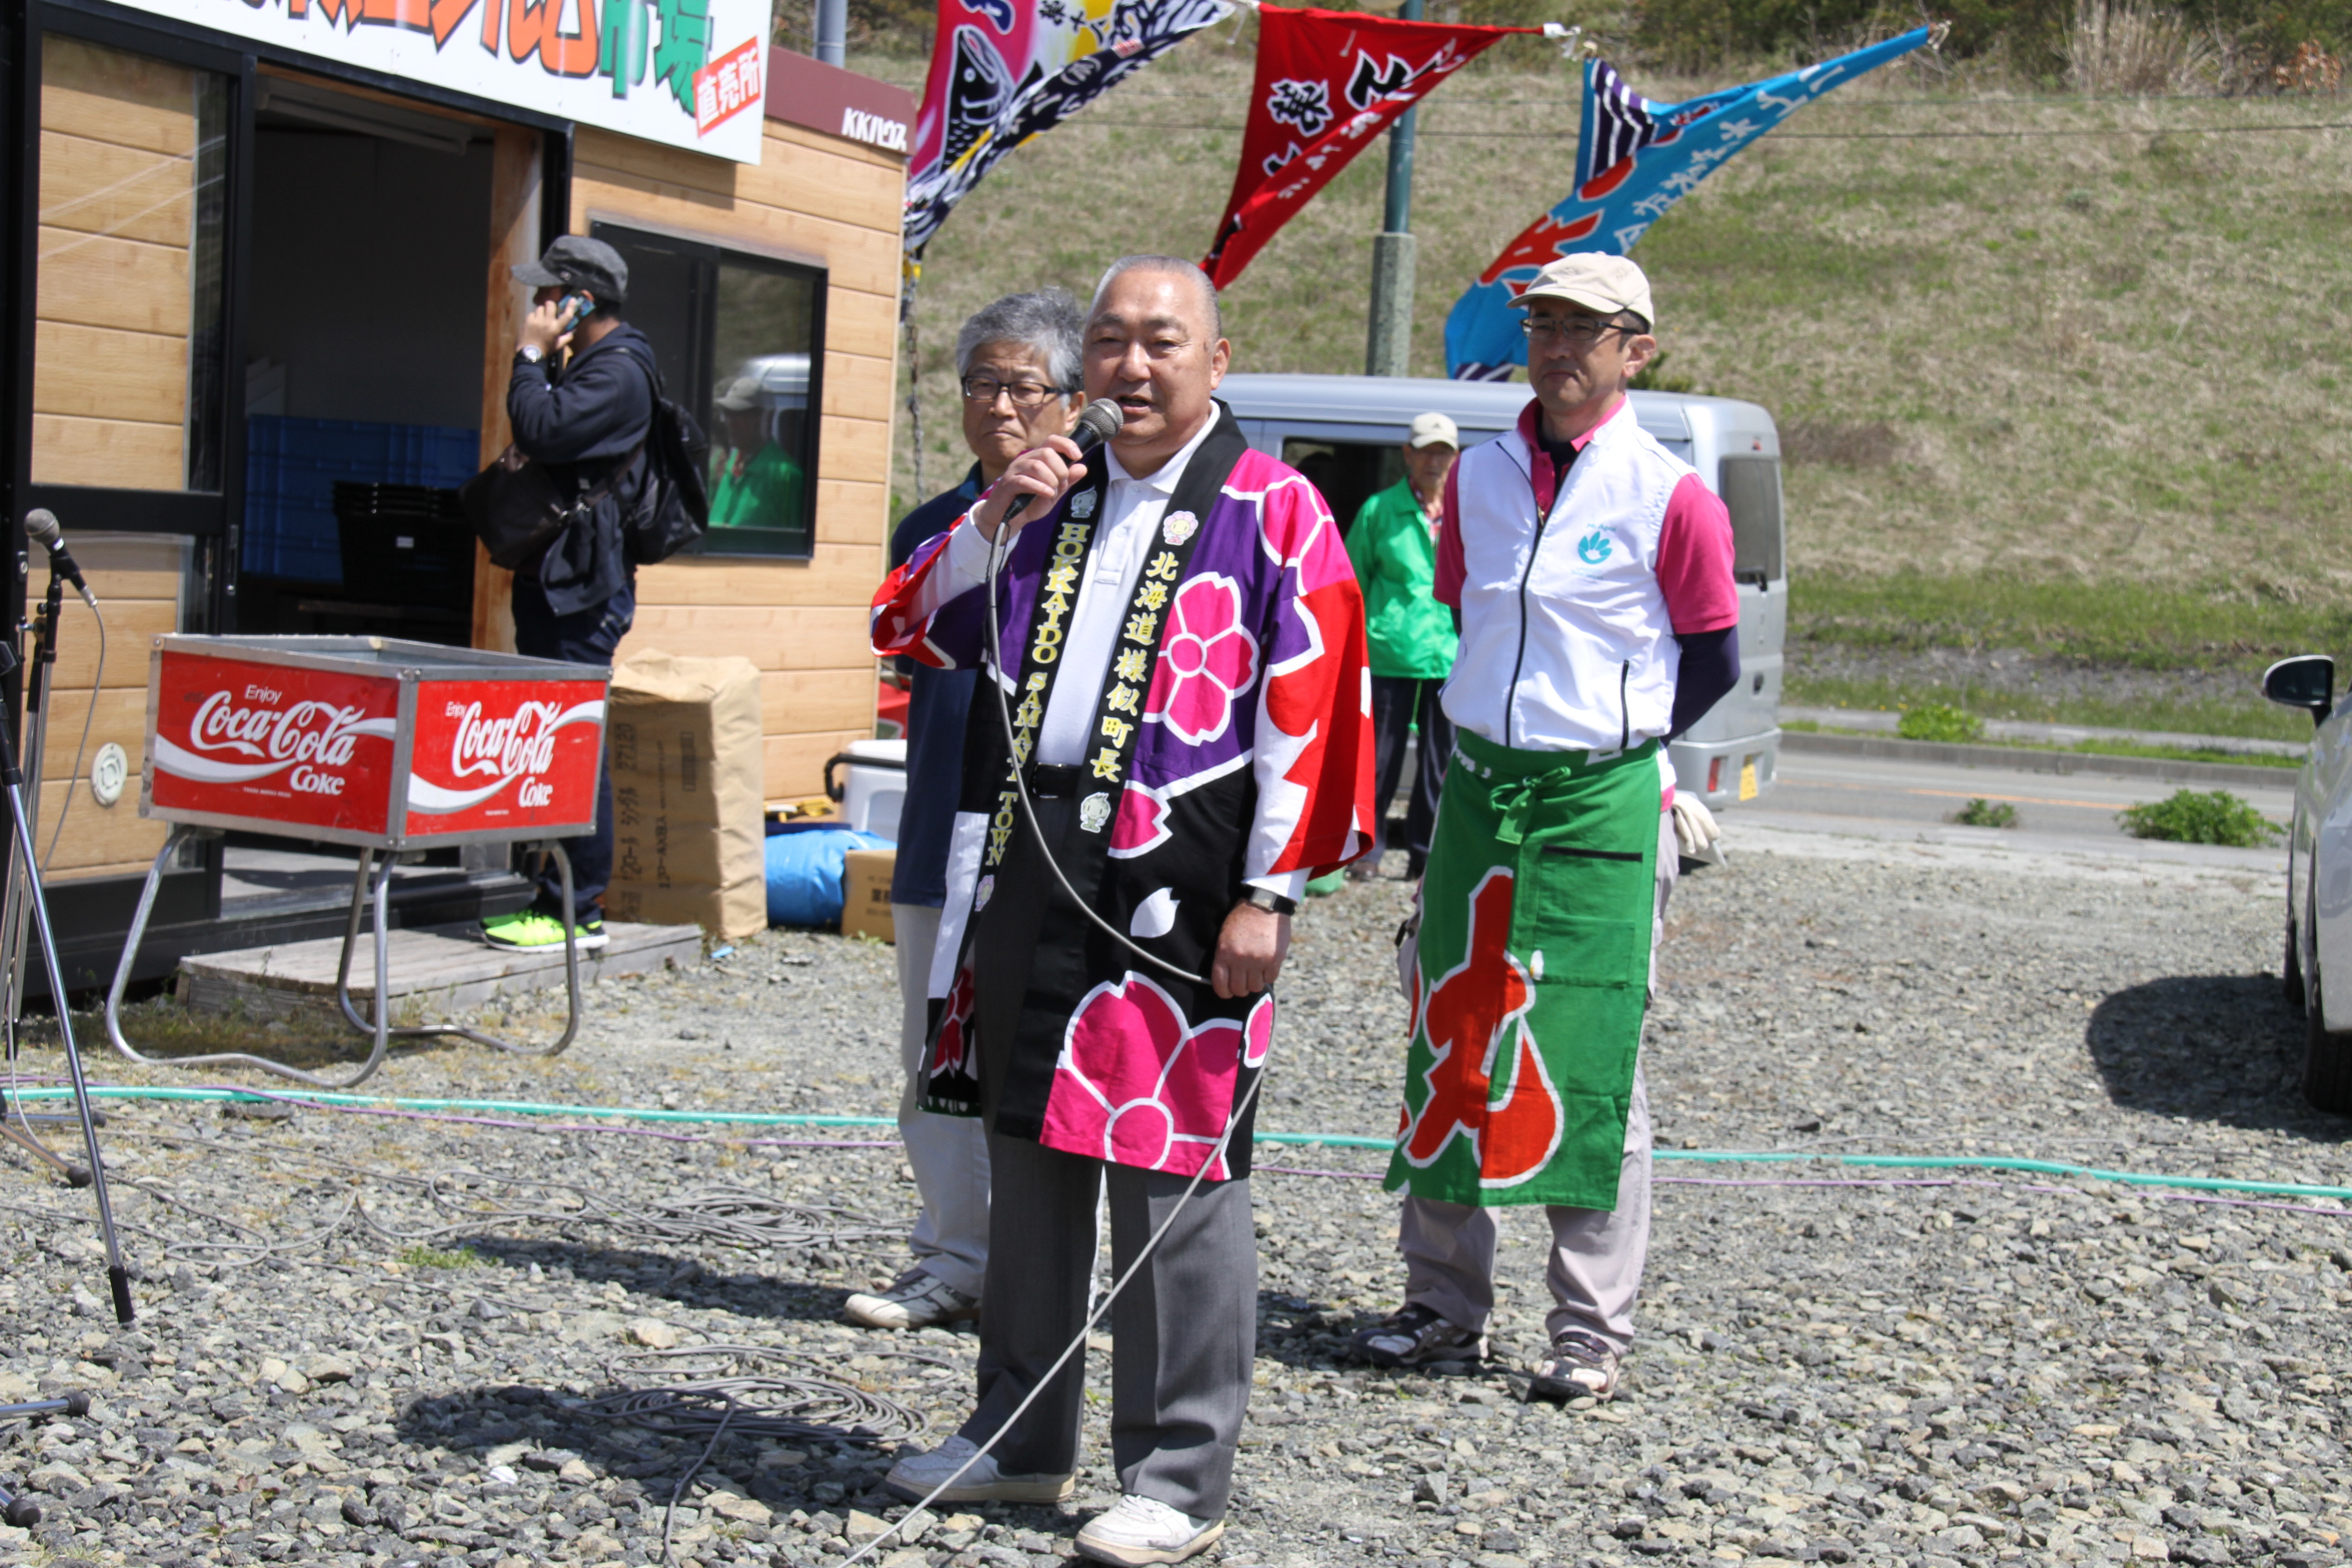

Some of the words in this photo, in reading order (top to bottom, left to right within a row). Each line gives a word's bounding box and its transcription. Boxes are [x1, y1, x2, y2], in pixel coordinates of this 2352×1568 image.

[697, 48, 759, 129] 直売所
[842, 107, 907, 152] KKハウス
[1032, 522, 1090, 664] HOKKAIDO
[245, 684, 282, 703] Enjoy
[1090, 550, 1179, 783] 北海道様似町長
[191, 690, 366, 767] Coca-Cola
[446, 701, 466, 718] Enjoy
[452, 701, 563, 778] Coca-Cola
[290, 764, 346, 795] Coke
[519, 776, 553, 808] Coke
[985, 791, 1019, 866] TOWN
